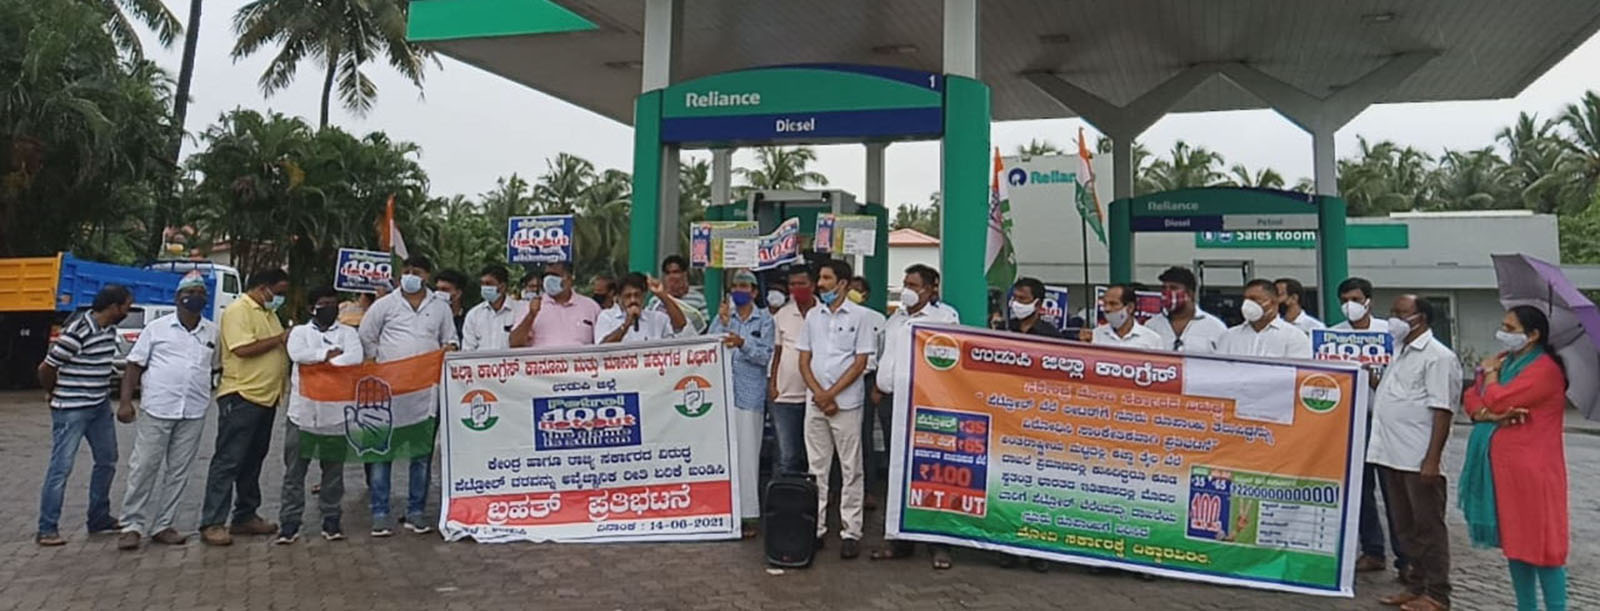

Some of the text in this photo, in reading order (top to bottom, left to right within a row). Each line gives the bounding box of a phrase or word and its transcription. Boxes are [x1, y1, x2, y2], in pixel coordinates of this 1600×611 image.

[929, 75, 936, 88] 1
[685, 92, 761, 108] Reliance
[775, 118, 816, 133] Diesel
[478, 358, 520, 383] ಕಾಂಗ್ರೆಸ್
[603, 353, 638, 370] ಮಾನವ
[687, 346, 718, 366] ವಿಭಾಗ
[970, 347, 1178, 386] ಉಡುಪಿ ಜಿಲ್ಲಾ ಕಾಂಗ್ರೆಸ್
[541, 406, 625, 421] 100
[488, 457, 521, 472] ಕೇಂದ್ರ
[527, 456, 561, 468] ಹಾಗೂ
[568, 455, 595, 470] ರಾಜ್ಯ
[600, 450, 652, 464] ಸರ್ಕಾರದ
[919, 463, 971, 486] ₹100
[455, 476, 505, 493] ಪೆಟ್ರೋಲ್
[588, 483, 691, 522] ಪ್ರತಿಭಟನೆ
[596, 521, 636, 532] ದಿನಾಂಕ
[650, 517, 724, 531] 14-06-2021
